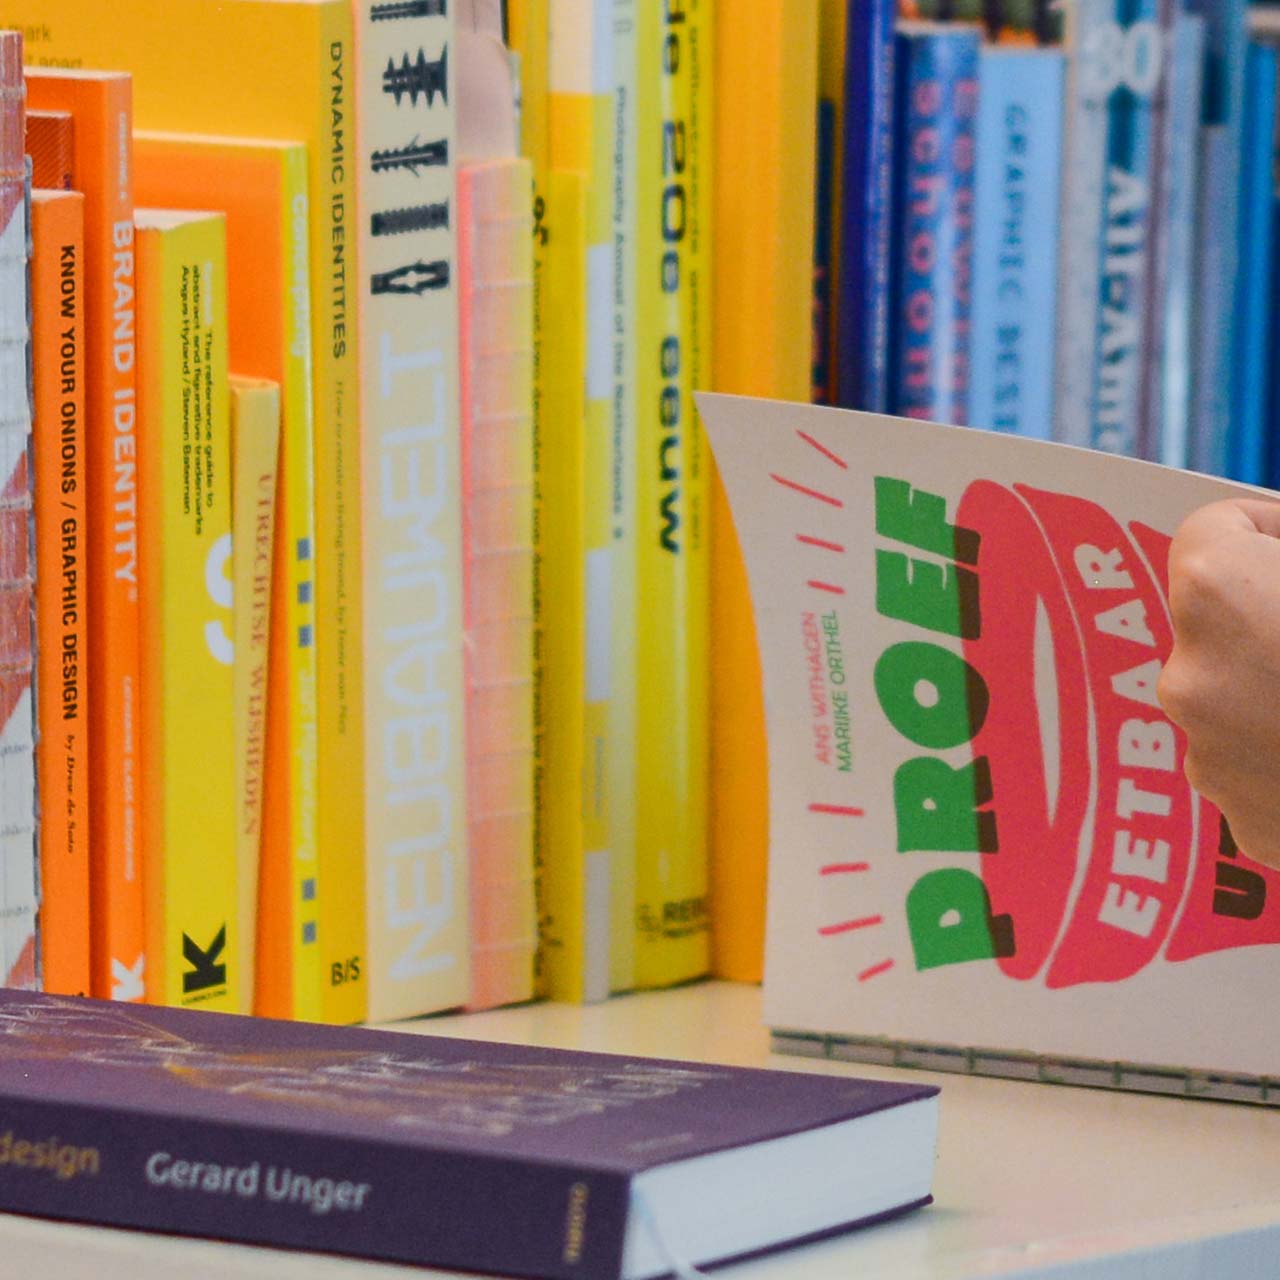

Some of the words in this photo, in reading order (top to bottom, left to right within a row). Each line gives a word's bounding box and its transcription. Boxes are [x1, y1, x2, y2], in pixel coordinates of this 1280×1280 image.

[330, 41, 344, 184] DYNAMIC
[661, 120, 687, 293] 20e
[997, 103, 1030, 304] GRAPHIC
[61, 245, 76, 318] KNOW
[113, 221, 135, 372] BRAND
[180, 265, 190, 316] Angus
[193, 265, 201, 329] abstract
[332, 194, 346, 359] IDENTITIES
[61, 326, 76, 394] YOUR
[180, 319, 191, 375] Hyland
[193, 335, 201, 363] and
[205, 333, 213, 361] The
[182, 387, 191, 441] Steven
[193, 368, 203, 441] figurative
[205, 364, 214, 441] reference
[61, 401, 76, 494] ONIONS
[183, 445, 192, 514] Bateman
[204, 445, 214, 488] guide
[660, 336, 682, 556] eeuw
[60, 501, 76, 511] /
[114, 388, 136, 583] IDENTITY
[194, 445, 204, 535] trademarks
[206, 492, 214, 508] to
[62, 518, 77, 626] GRAPHIC
[62, 634, 77, 720] DESIGN
[801, 610, 828, 717] WITHAGEN
[820, 609, 846, 685] ORTHEL
[65, 734, 75, 751] by
[811, 724, 832, 765] ANS
[830, 691, 853, 773] MARIJKE
[874, 476, 1015, 972] PROEF
[1072, 542, 1178, 938] EETBAAR
[66, 798, 75, 816] de
[146, 1151, 261, 1197] Gerard
[265, 1167, 372, 1214] Unger
